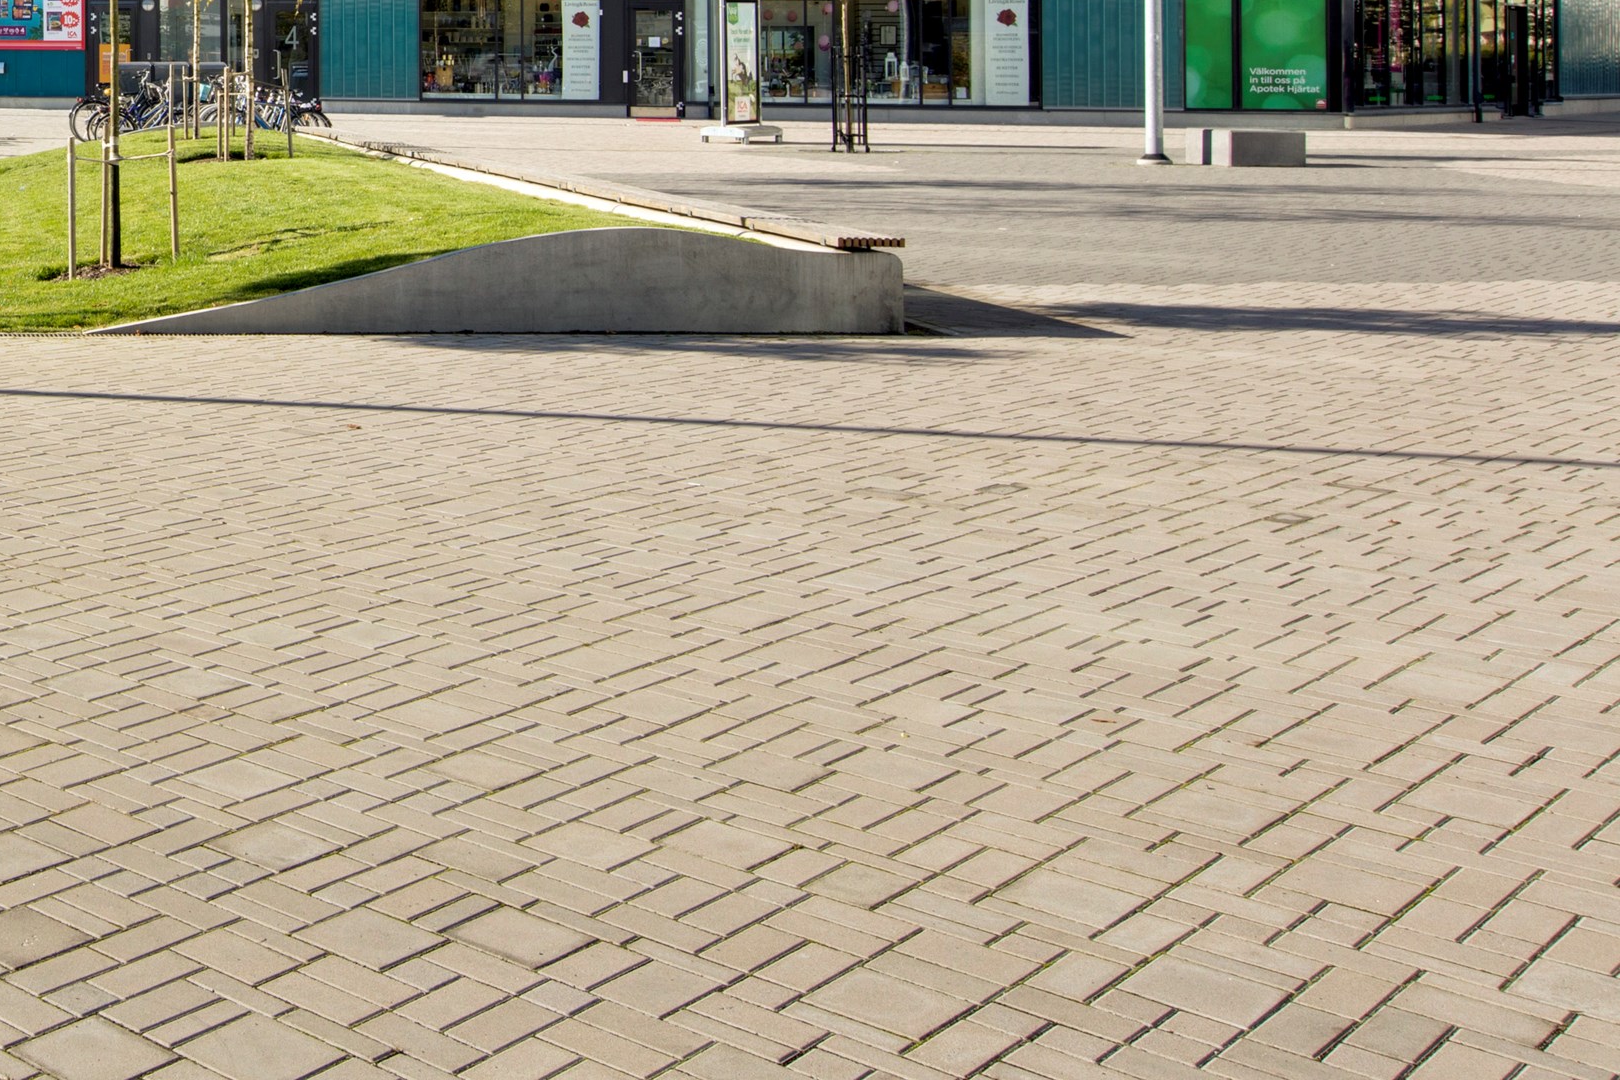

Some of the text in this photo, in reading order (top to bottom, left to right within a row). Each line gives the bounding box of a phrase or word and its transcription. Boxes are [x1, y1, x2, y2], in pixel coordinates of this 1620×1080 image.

[285, 25, 300, 50] 4
[1249, 67, 1306, 76] Välkommen
[1249, 76, 1258, 84] in
[1261, 76, 1272, 84] till
[1293, 75, 1306, 86] på
[1249, 85, 1320, 94] Apotek Hjärtat
